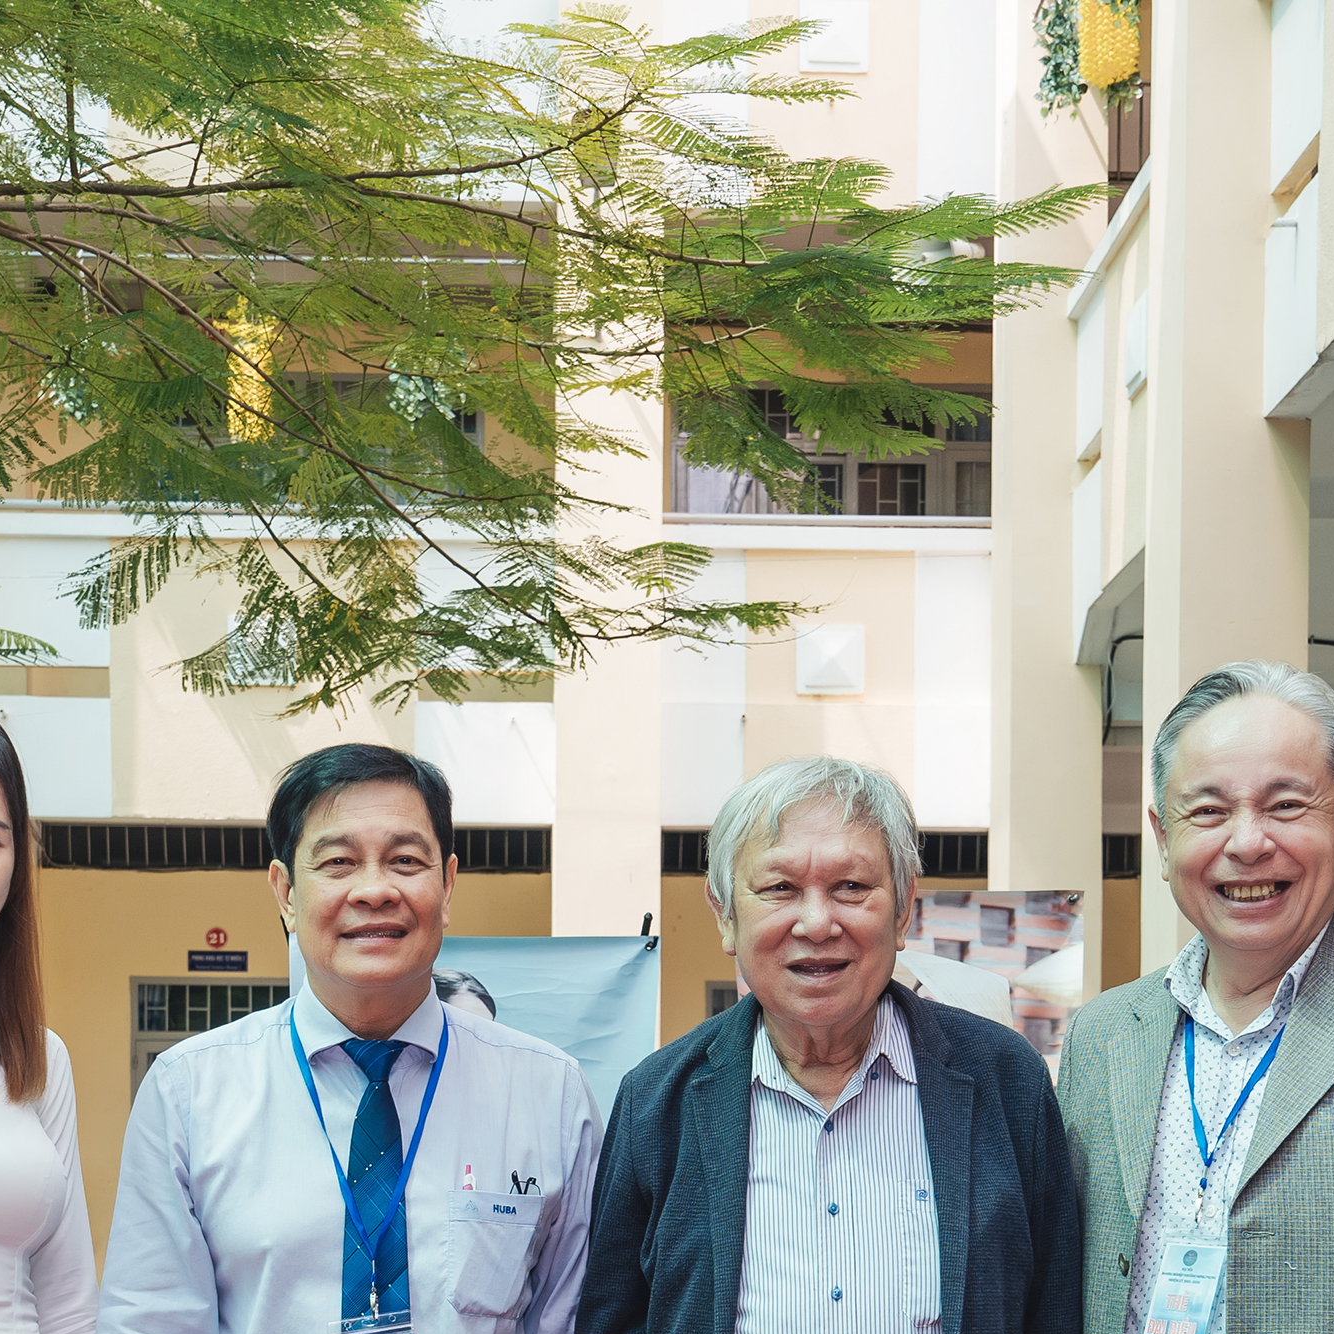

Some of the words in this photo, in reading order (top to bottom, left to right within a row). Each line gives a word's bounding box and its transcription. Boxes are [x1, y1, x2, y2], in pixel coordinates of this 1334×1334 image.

[208, 933, 224, 944] 21
[492, 1203, 517, 1215] HUBA
[1167, 1290, 1190, 1312] THẺ
